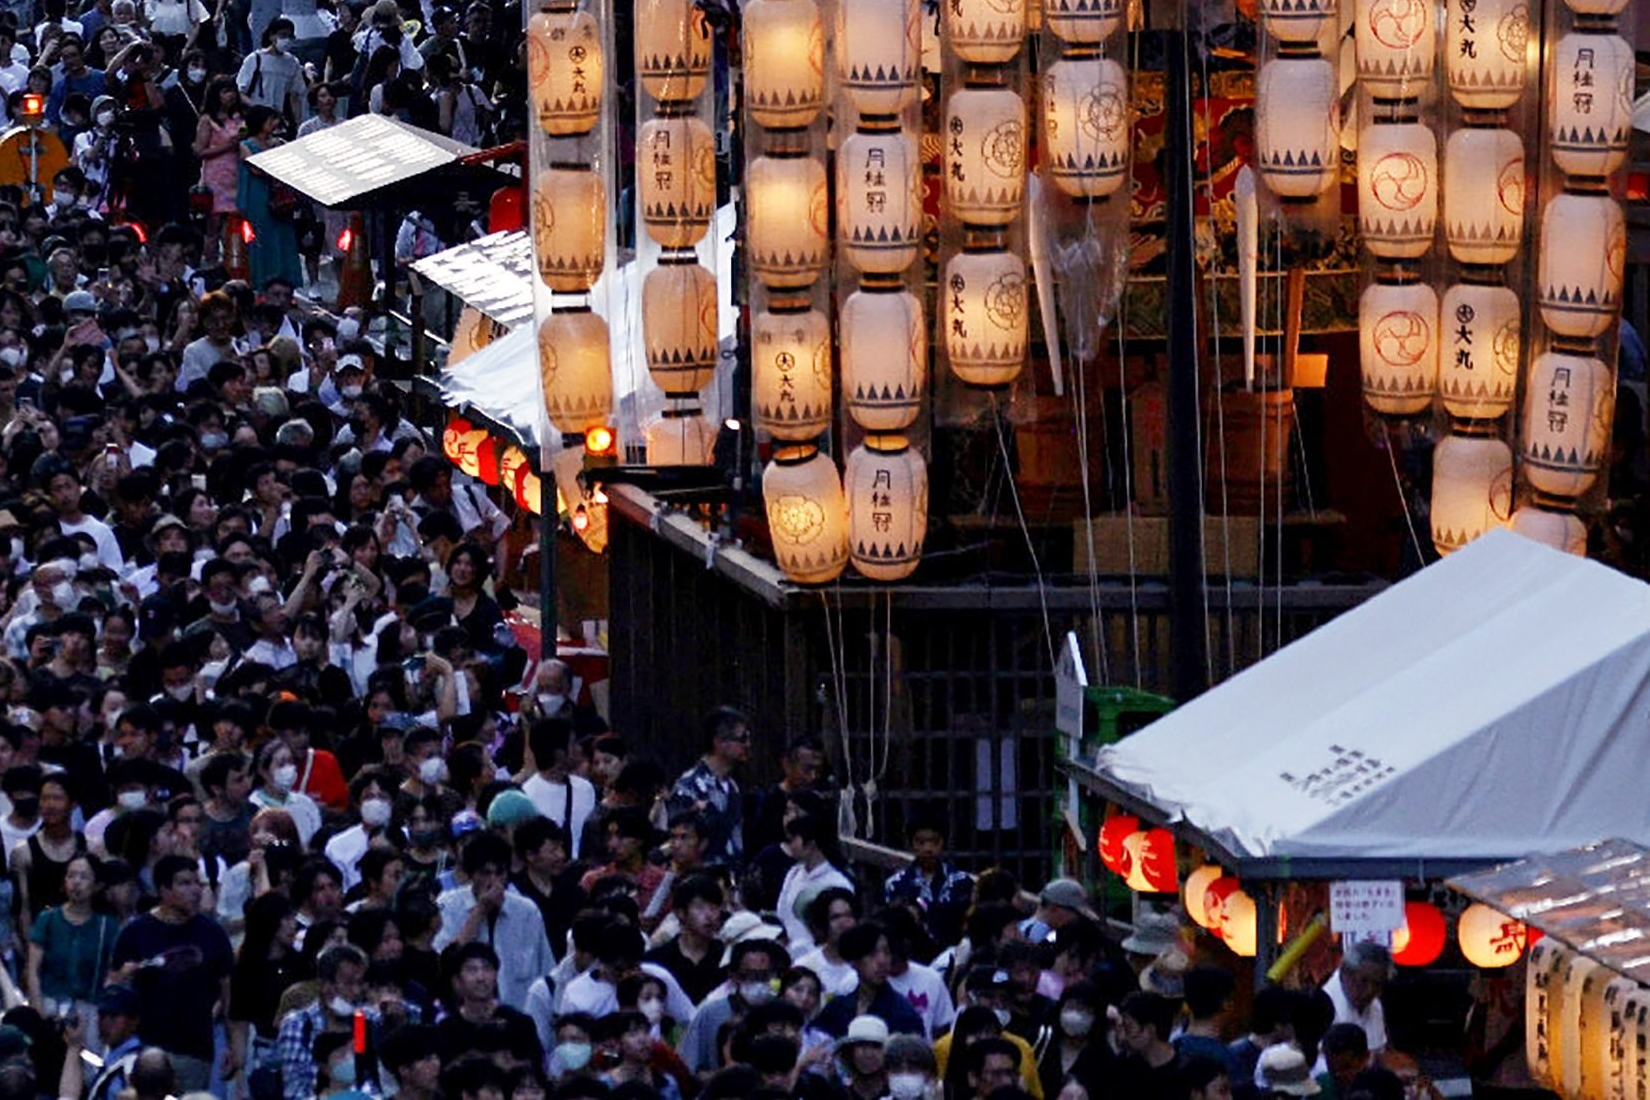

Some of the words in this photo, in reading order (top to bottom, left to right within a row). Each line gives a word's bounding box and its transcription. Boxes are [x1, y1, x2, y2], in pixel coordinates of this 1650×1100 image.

[1573, 48, 1595, 115] 月桂冠
[653, 130, 672, 191] 月桂冠
[864, 148, 887, 214] 月桂冠
[1547, 367, 1572, 434] 月桂冠
[871, 468, 892, 533] 月桂冠
